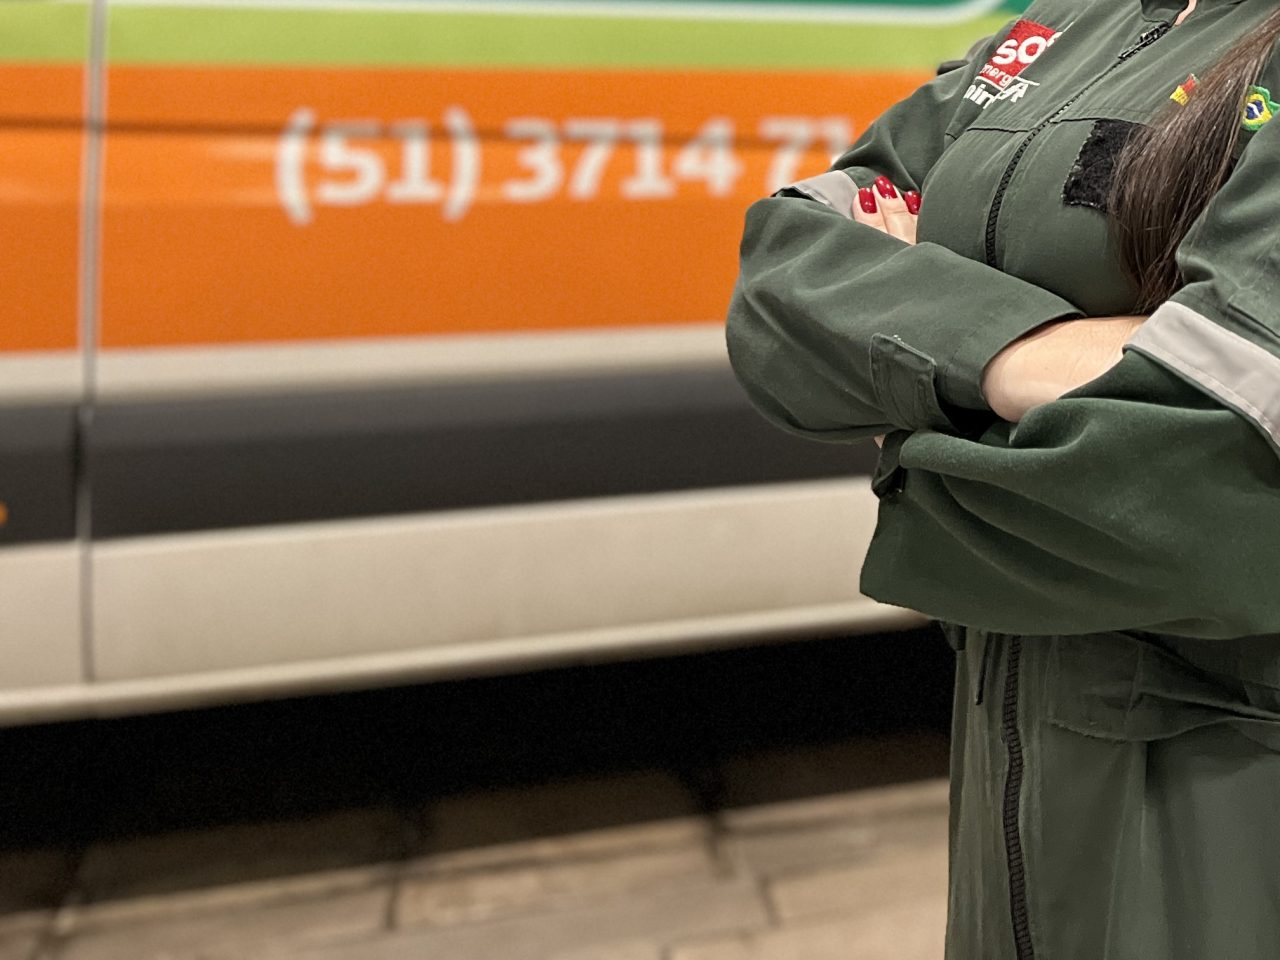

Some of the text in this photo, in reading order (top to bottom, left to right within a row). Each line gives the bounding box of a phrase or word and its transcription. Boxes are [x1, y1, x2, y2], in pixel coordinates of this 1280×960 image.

[275, 106, 855, 225] (51) 3714 71
